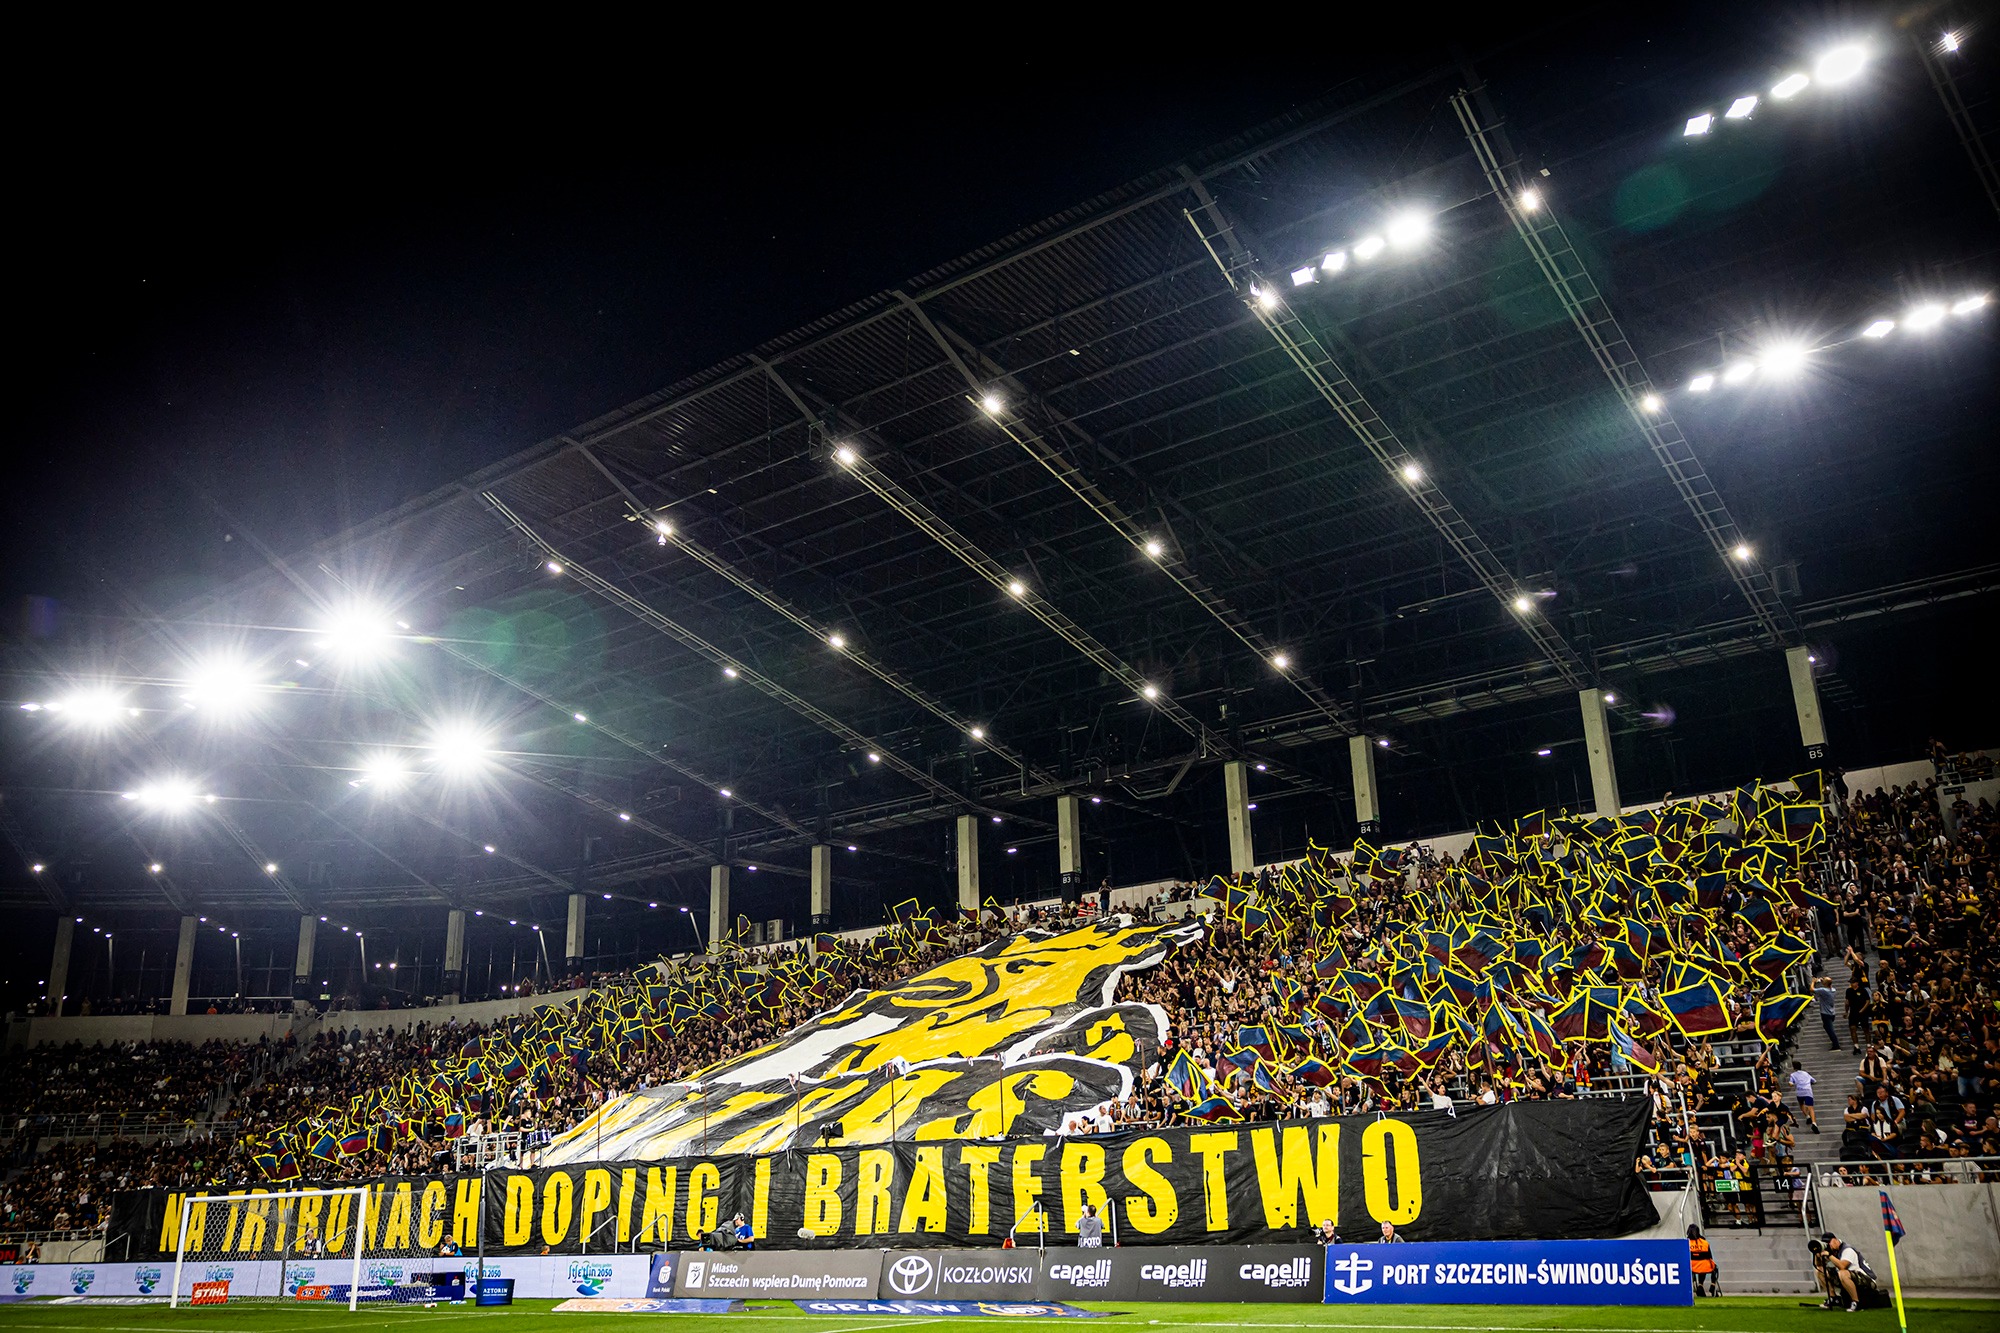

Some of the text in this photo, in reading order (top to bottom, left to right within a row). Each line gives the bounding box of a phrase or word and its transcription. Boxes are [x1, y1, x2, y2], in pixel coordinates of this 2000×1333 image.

[1808, 749, 1824, 760] B5
[1360, 825, 1372, 834] B4
[159, 1117, 1424, 1253] NA TRYBUNACH DOPING I BRATERSTWO
[1775, 1179, 1790, 1190] 14
[1083, 1237, 1101, 1246] FOTO
[597, 1268, 613, 1277] 2050
[711, 1262, 738, 1273] Miasto
[1049, 1259, 1112, 1284] capelli
[1140, 1258, 1208, 1285] capelli
[1239, 1257, 1311, 1286] capelli
[1382, 1258, 1680, 1286] PORT SZCZECIN-ŚWINOUJŚCIE
[487, 1269, 502, 1278] 2050
[943, 1266, 1033, 1284] KOZŁOWSKI
[708, 1274, 868, 1291] Szczecin wspiera Dumę Pomorza
[1075, 1278, 1109, 1287] SPORT
[1169, 1278, 1206, 1288] SPORT
[1270, 1278, 1310, 1288] SPORT
[194, 1287, 227, 1298] STIHL
[809, 1302, 962, 1314] GRAJ W
